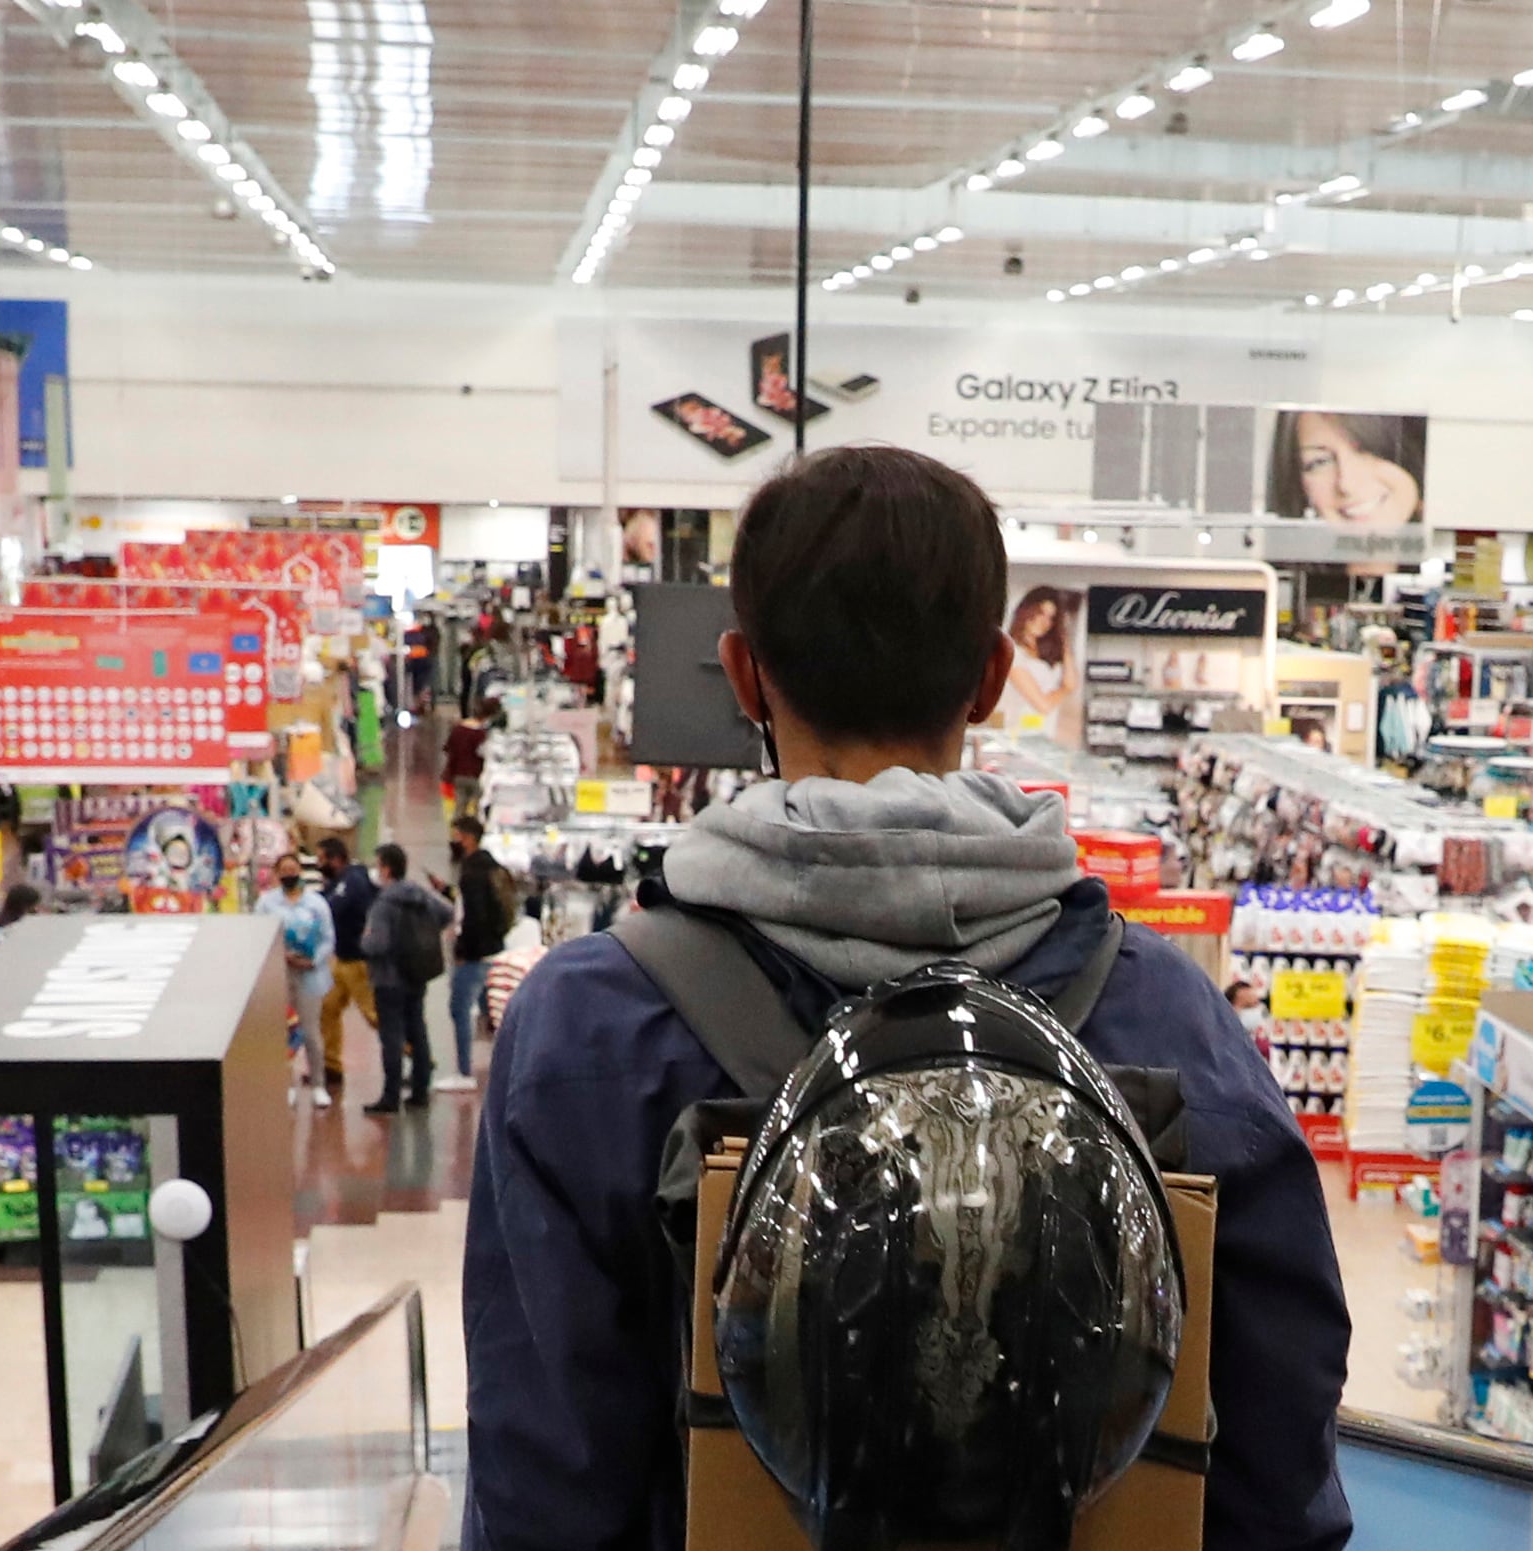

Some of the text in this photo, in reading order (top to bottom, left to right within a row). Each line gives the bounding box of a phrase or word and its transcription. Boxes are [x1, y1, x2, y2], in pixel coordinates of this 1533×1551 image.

[955, 373, 1072, 410] Galaxy
[1081, 377, 1100, 403] Z
[927, 413, 1057, 441] Expande
